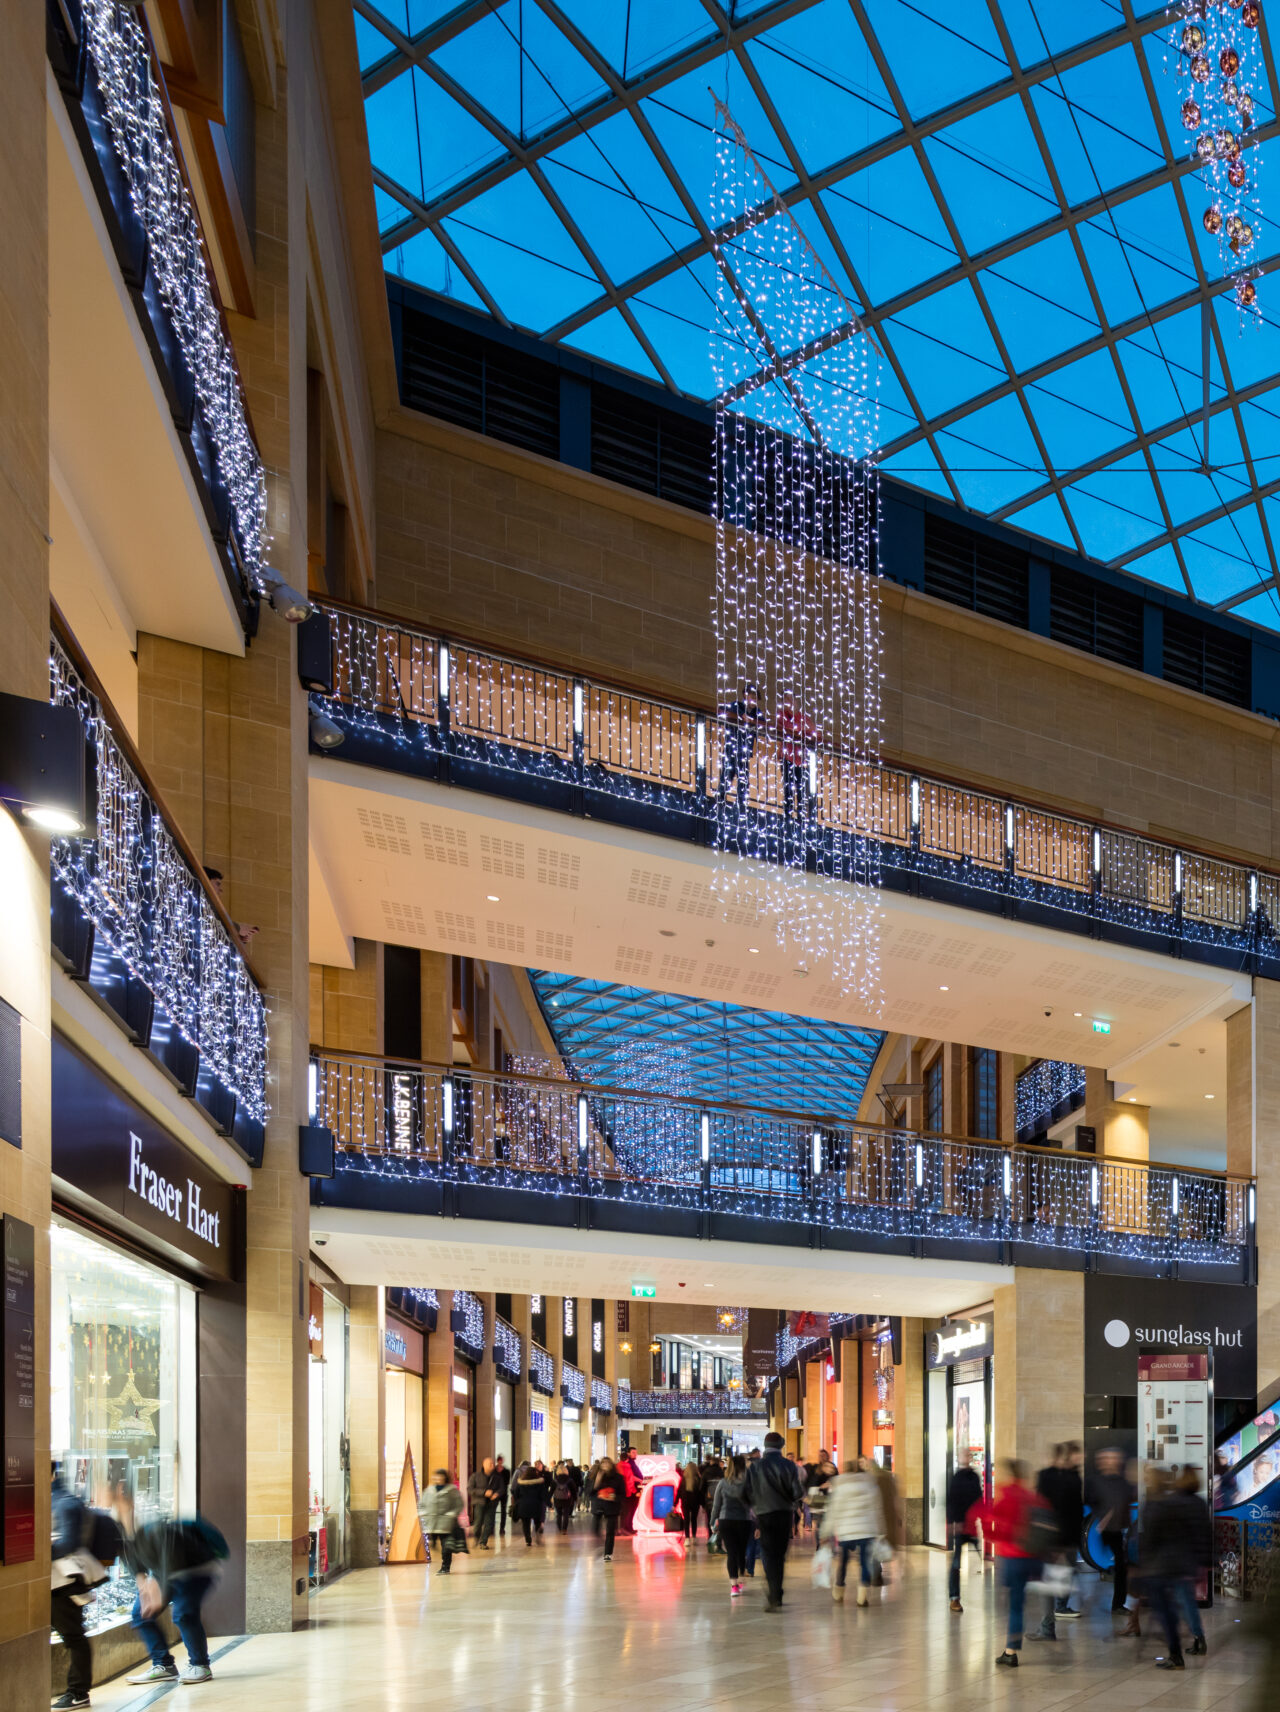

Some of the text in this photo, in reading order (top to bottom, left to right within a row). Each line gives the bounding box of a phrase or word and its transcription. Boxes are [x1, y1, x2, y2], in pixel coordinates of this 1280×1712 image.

[128, 1130, 220, 1248] Fraser Hart
[1135, 1324, 1244, 1348] sunglass hut
[1145, 1384, 1152, 1395] 2
[1146, 1422, 1150, 1433] 1
